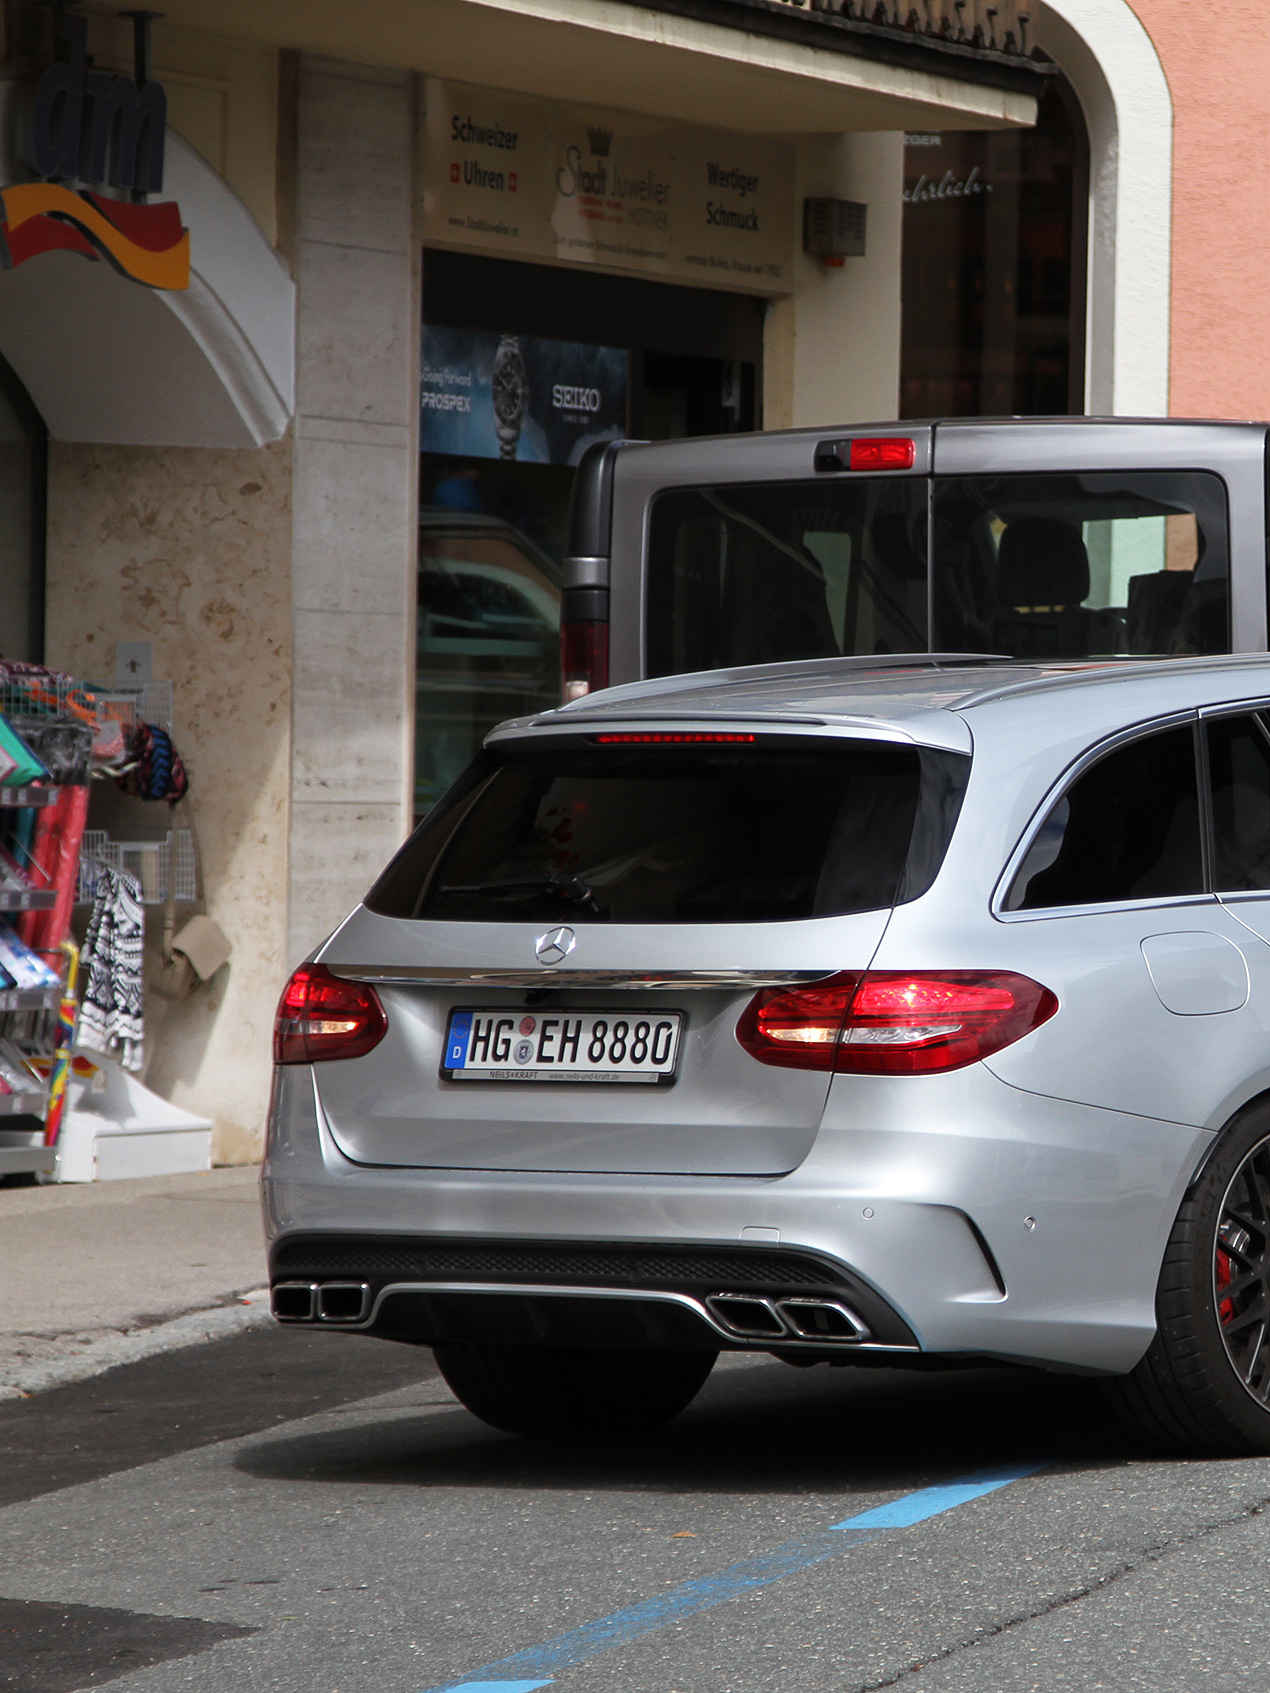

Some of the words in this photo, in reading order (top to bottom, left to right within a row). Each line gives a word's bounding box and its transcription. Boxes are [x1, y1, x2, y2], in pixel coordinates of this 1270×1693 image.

[34, 14, 167, 193] dm
[451, 115, 518, 150] Schweizer
[464, 160, 504, 190] Uhren
[556, 145, 606, 197] Stadt
[610, 163, 669, 205] Juwelier
[707, 163, 759, 197] Wertiger
[706, 202, 759, 231] Schmuck
[421, 391, 471, 413] PROSPEX
[552, 384, 601, 412] SEIKO
[452, 1046, 461, 1059] D
[469, 1019, 514, 1063] HG
[536, 1019, 582, 1063] EH
[588, 1020, 672, 1065] 8880
